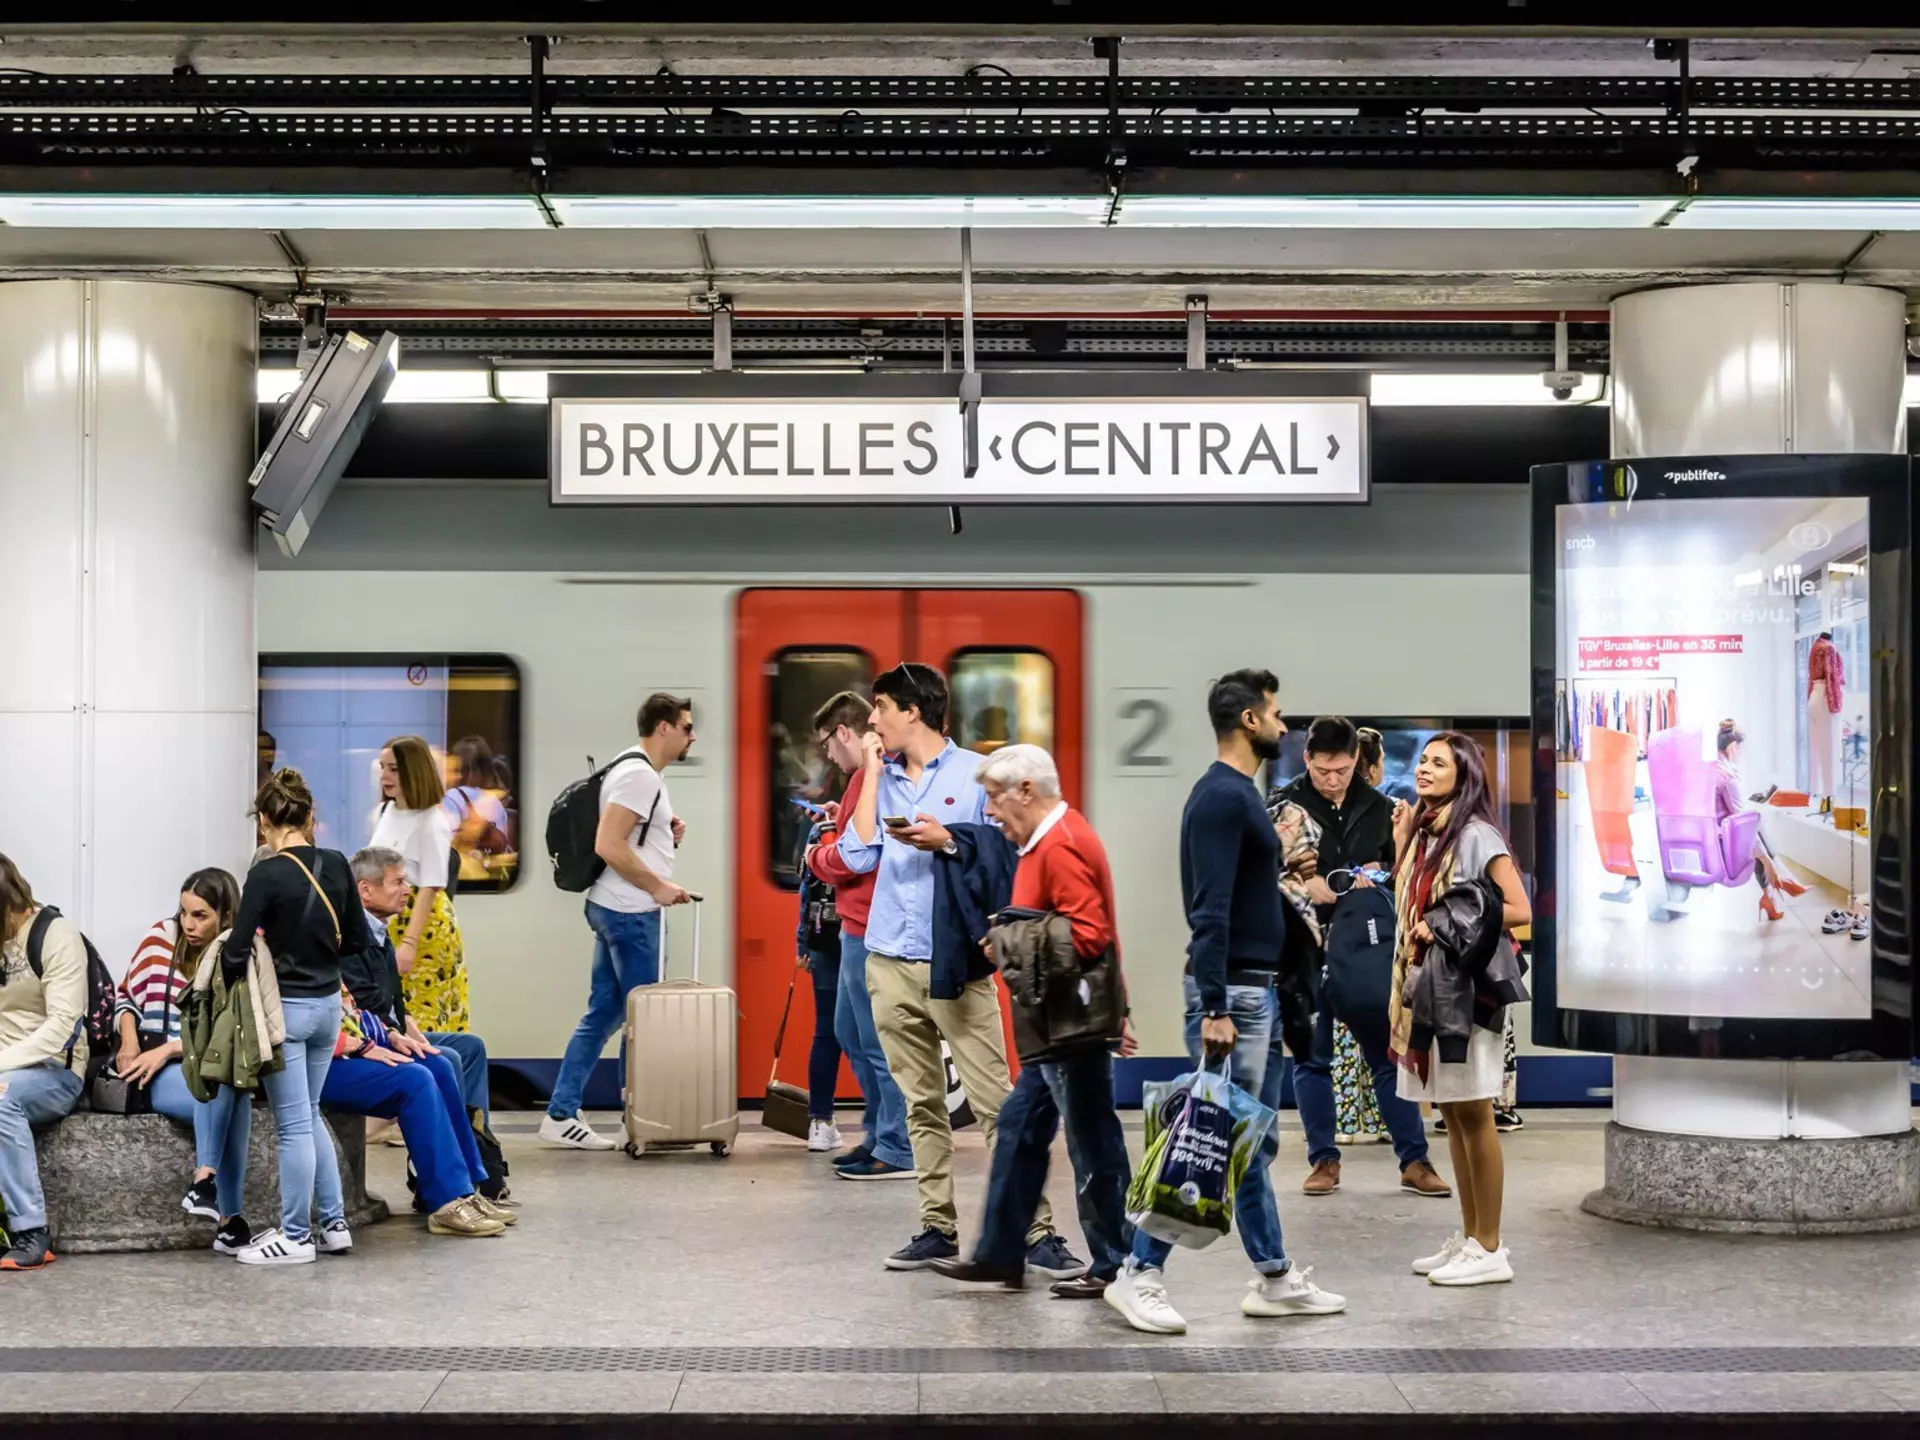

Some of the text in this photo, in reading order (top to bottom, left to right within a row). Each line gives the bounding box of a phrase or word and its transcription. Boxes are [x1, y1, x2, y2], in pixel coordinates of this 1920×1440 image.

[580, 421, 937, 476] BRUXELLES
[1674, 469, 1720, 484] publifer
[1566, 535, 1596, 550] sncb
[1682, 641, 1698, 651] en
[1701, 639, 1716, 650] 35
[1719, 638, 1743, 650] min
[1586, 656, 1613, 670] partir
[1615, 656, 1629, 668] de
[1116, 699, 1174, 766] 2
